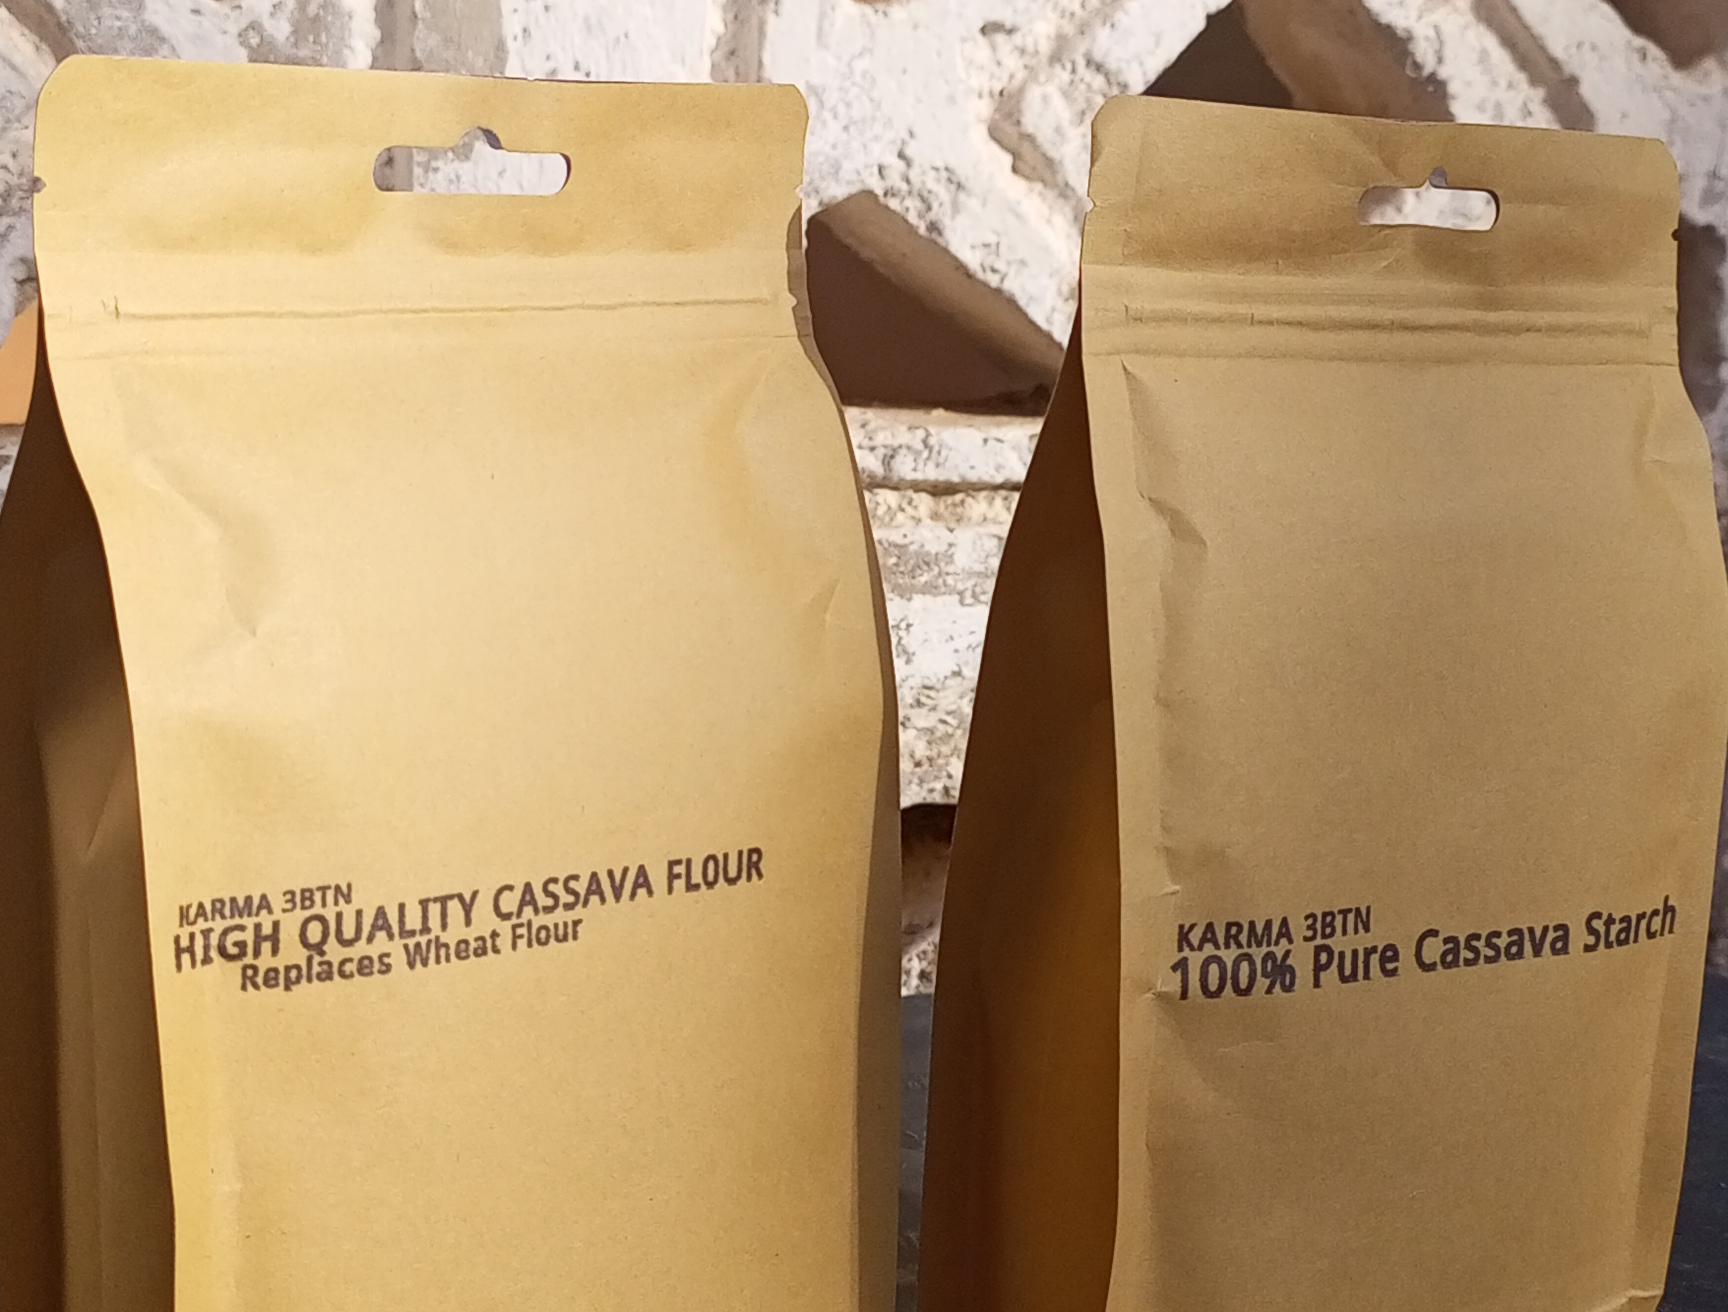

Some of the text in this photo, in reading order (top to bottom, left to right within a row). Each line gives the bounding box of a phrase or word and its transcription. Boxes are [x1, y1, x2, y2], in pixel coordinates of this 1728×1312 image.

[173, 846, 765, 974] HIGH QUALITY CASSAVA FLOUR
[178, 882, 353, 929] KARMA 3BTN
[1177, 904, 1372, 954] KARMA 3BTN
[239, 915, 584, 993] Replaces Wheat Flour
[1170, 894, 1677, 1001] 100% Pure Cassava Starch
